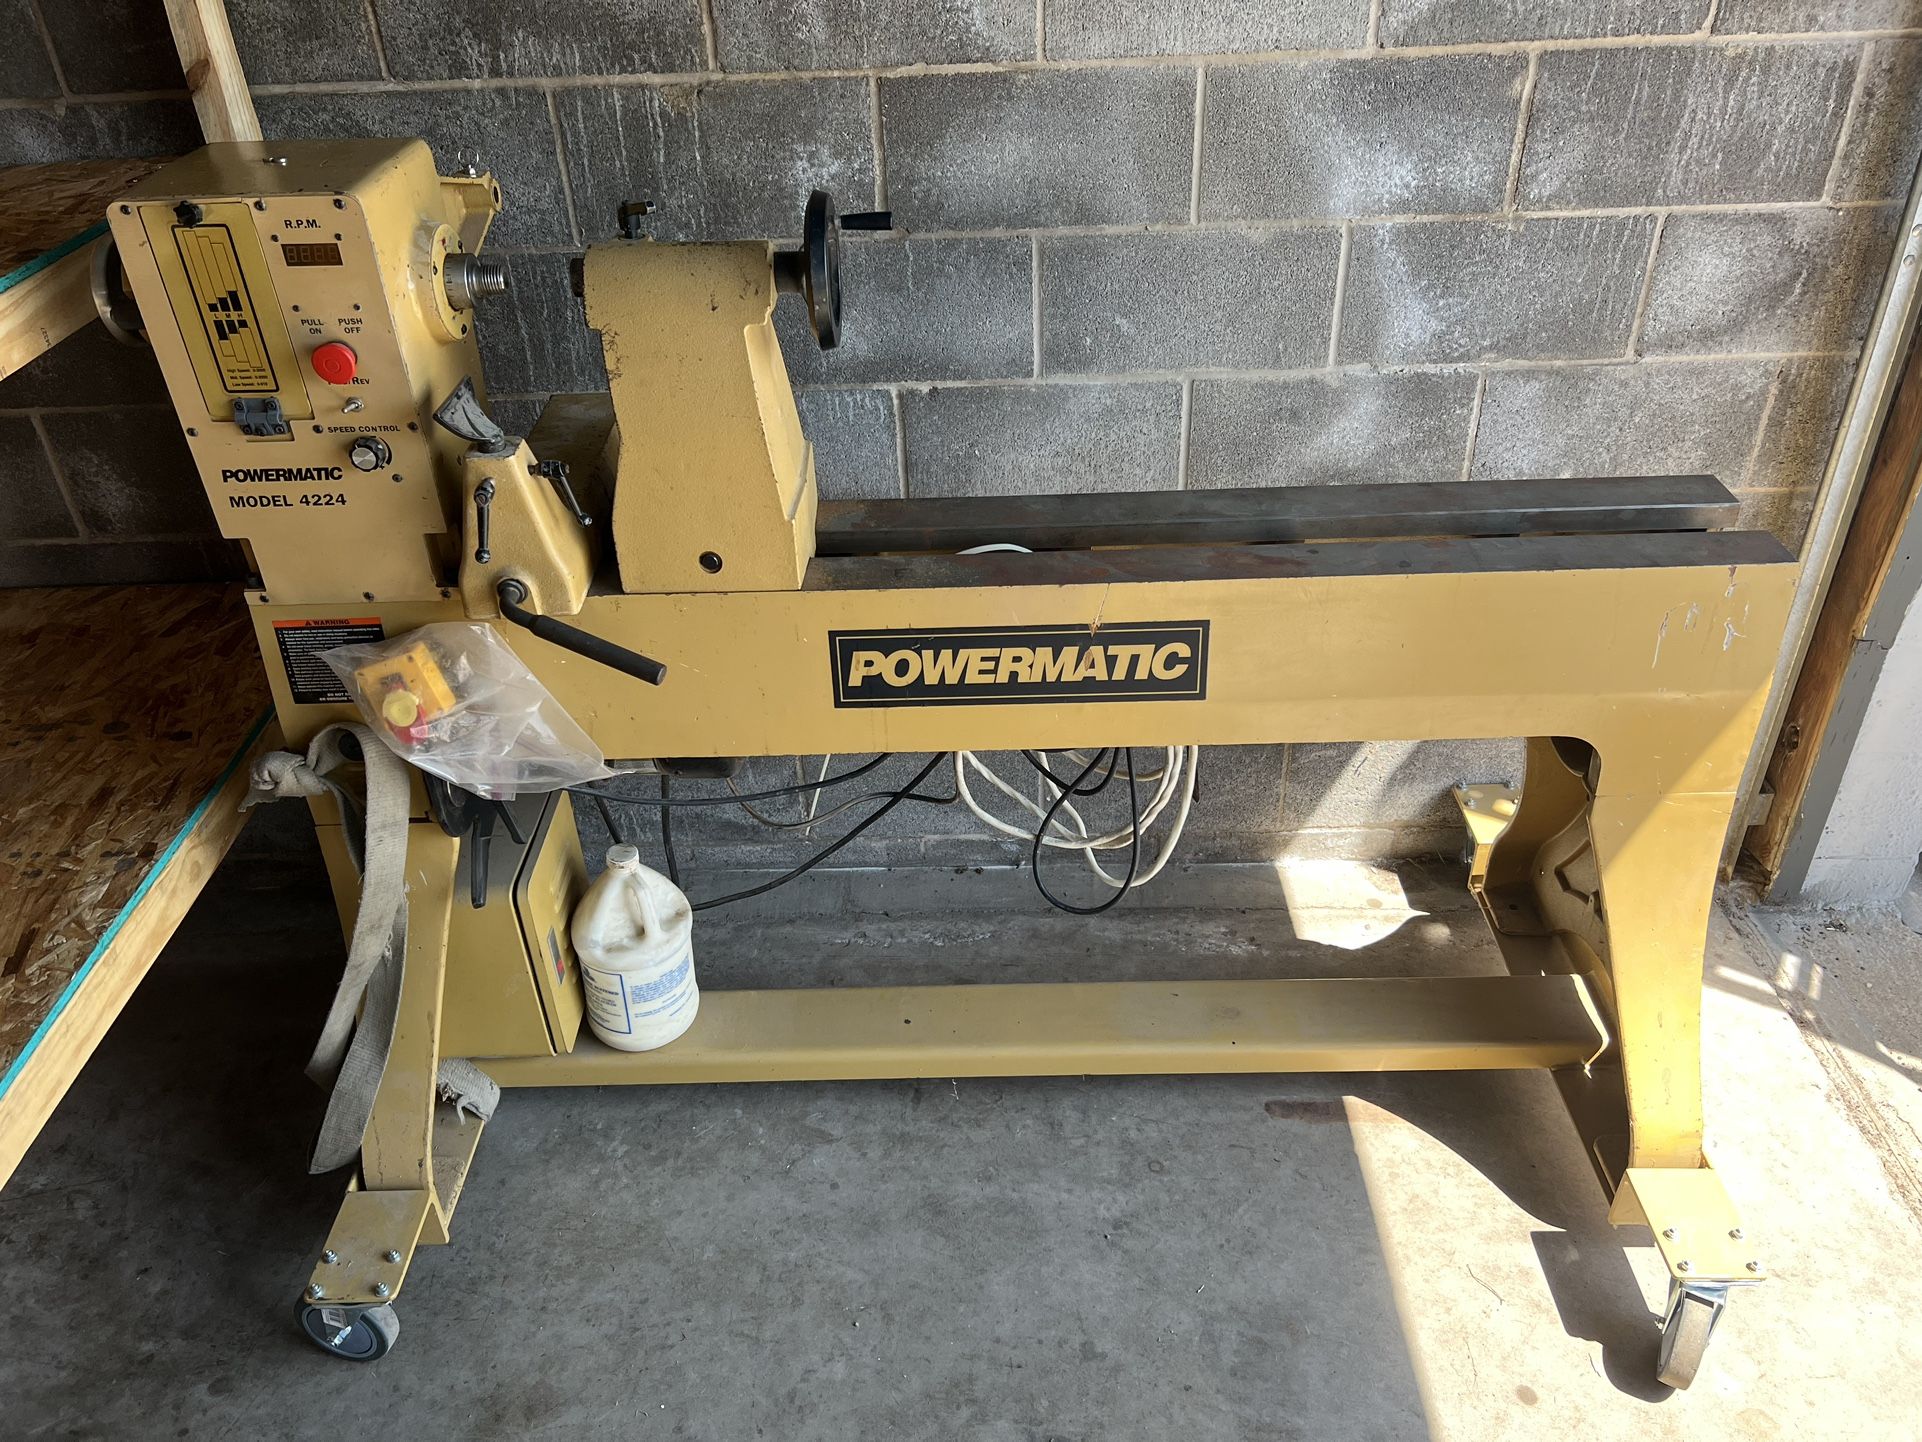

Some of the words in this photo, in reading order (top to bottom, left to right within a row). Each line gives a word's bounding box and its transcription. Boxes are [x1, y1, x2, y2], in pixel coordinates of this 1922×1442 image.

[284, 219, 321, 229] R.P.M.
[338, 317, 363, 326] PUSH
[222, 467, 343, 483] POWERMATIC
[229, 495, 293, 508] MODEL
[300, 494, 347, 506] 4224
[847, 642, 1192, 687] POWERMATIC
